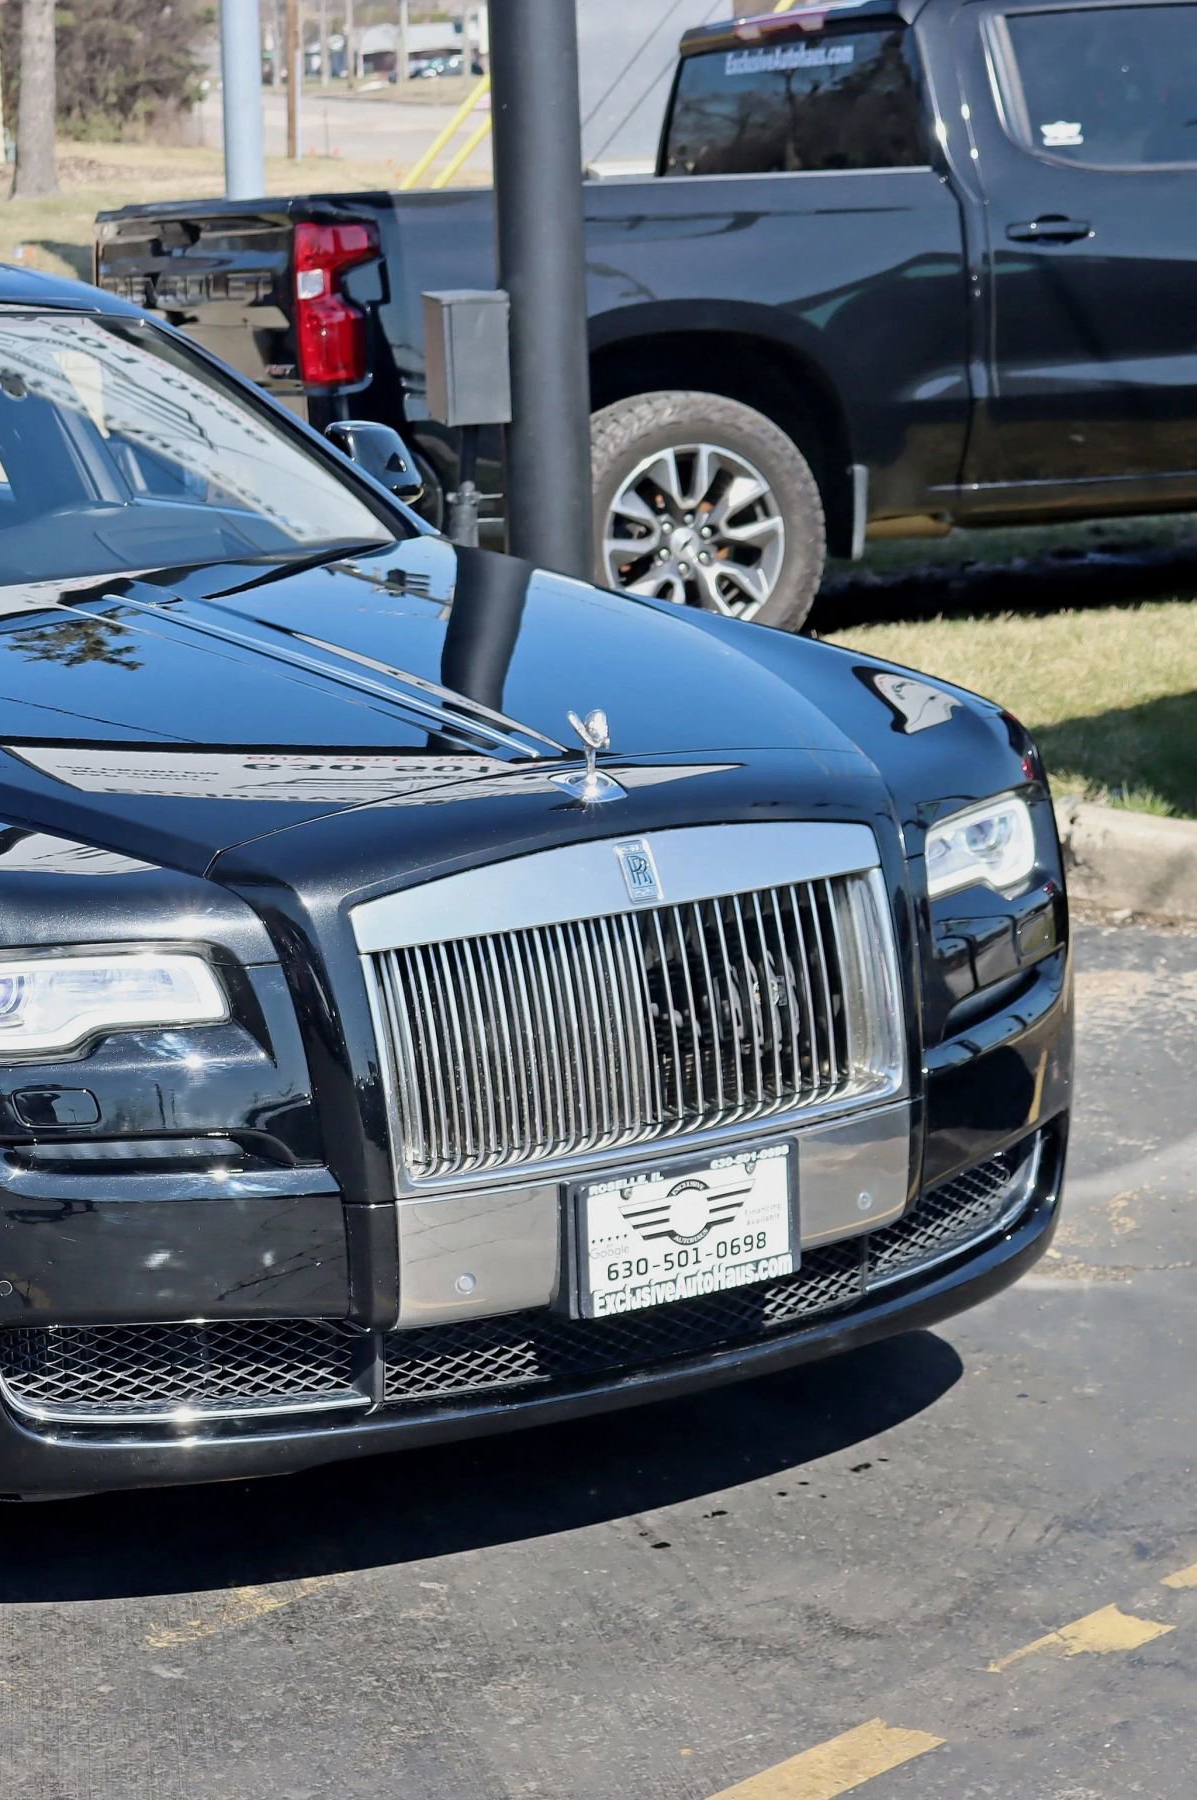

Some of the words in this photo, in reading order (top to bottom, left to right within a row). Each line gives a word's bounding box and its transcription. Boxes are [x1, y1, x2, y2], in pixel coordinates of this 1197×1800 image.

[651, 1171, 665, 1182] IL
[607, 1231, 768, 1281] 630-501-0698
[592, 1253, 793, 1317] ExclusiveAutoHaus.com
